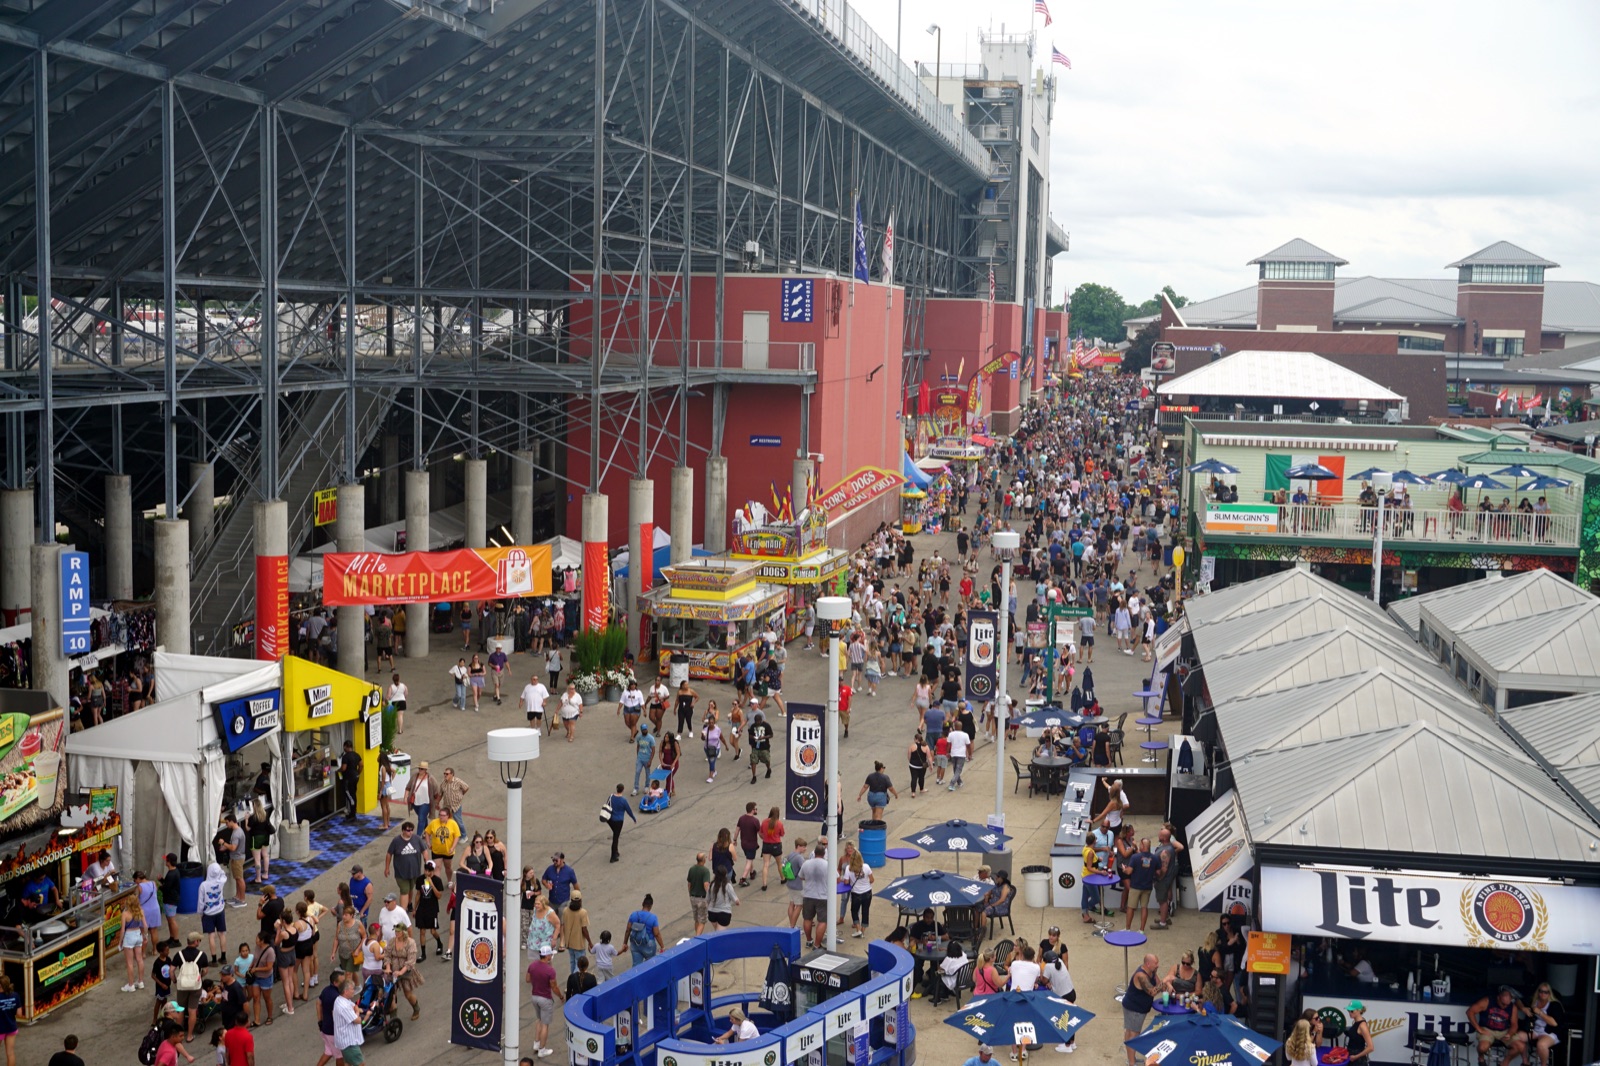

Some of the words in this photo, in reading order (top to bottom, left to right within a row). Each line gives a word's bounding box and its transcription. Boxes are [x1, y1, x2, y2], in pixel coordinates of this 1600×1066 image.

[823, 489, 846, 510] CORN
[851, 471, 876, 492] DOGS
[345, 554, 387, 574] Mile
[763, 567, 785, 577] DOGS
[797, 569, 816, 578] LIMEADE
[70, 558, 82, 615] RAMP
[343, 570, 472, 597] MARKETPLACE
[277, 560, 288, 657] MARKETPLACE
[261, 625, 276, 657] Mile
[975, 628, 993, 641] Lite
[70, 637, 85, 649] 10
[313, 687, 328, 701] Mini
[253, 699, 271, 714] COFFEE
[258, 714, 276, 727] FRAPPE
[796, 726, 820, 743] Lite
[1189, 800, 1236, 856] Lite
[15, 862, 35, 878] SOBA
[37, 846, 73, 868] NOODLES
[892, 889, 914, 901] Lite
[1227, 884, 1251, 900] Lite
[1479, 885, 1496, 900] FINE
[1499, 884, 1530, 910] PILSNER
[1314, 870, 1440, 938] Lite
[467, 908, 496, 935] Lite
[878, 993, 891, 1009] Lite
[466, 1004, 488, 1016] LEFF'S
[838, 1012, 852, 1028] Lite
[1366, 1017, 1406, 1034] Miller
[1016, 1026, 1033, 1035] Lite
[800, 1034, 814, 1051] Lite
[1189, 1053, 1231, 1066] Miller
